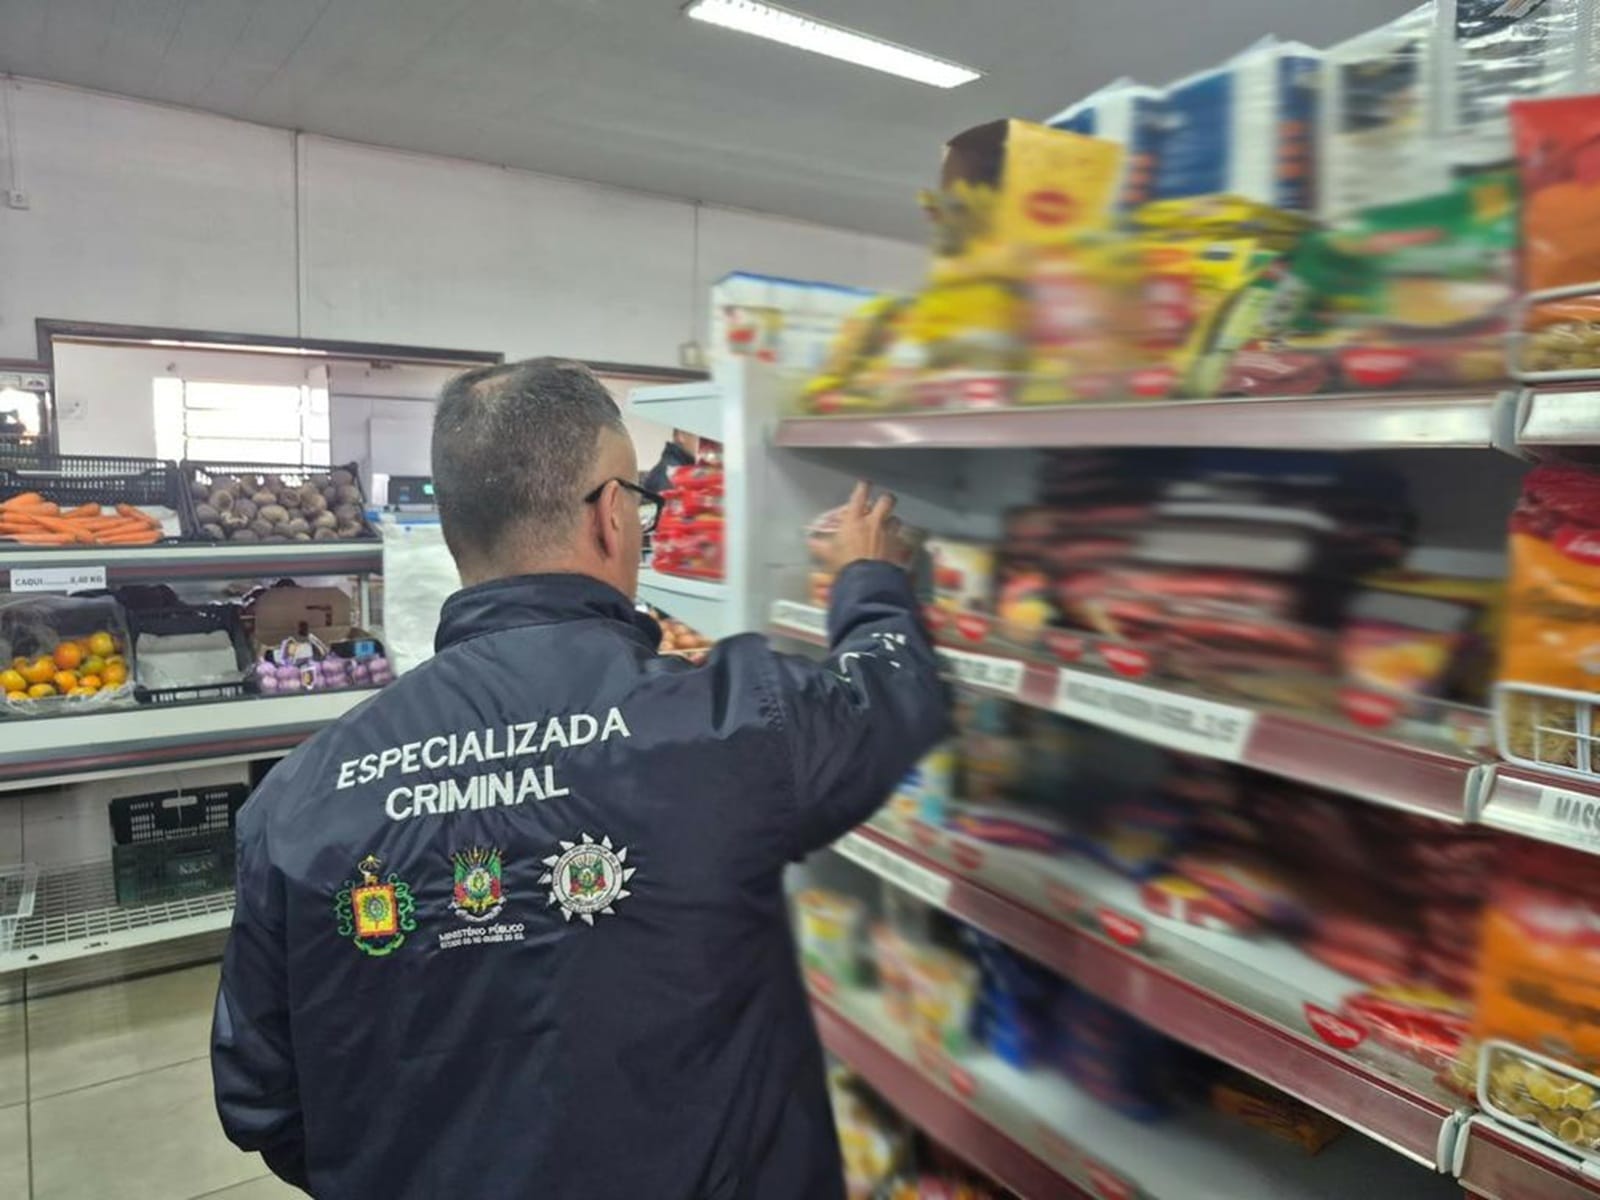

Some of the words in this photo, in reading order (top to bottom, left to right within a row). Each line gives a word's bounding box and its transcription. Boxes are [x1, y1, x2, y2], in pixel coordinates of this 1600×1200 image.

[15, 578, 44, 586] CAQUI
[336, 707, 631, 789] ESPECIALIZADA
[385, 765, 569, 821] CRIMINAL
